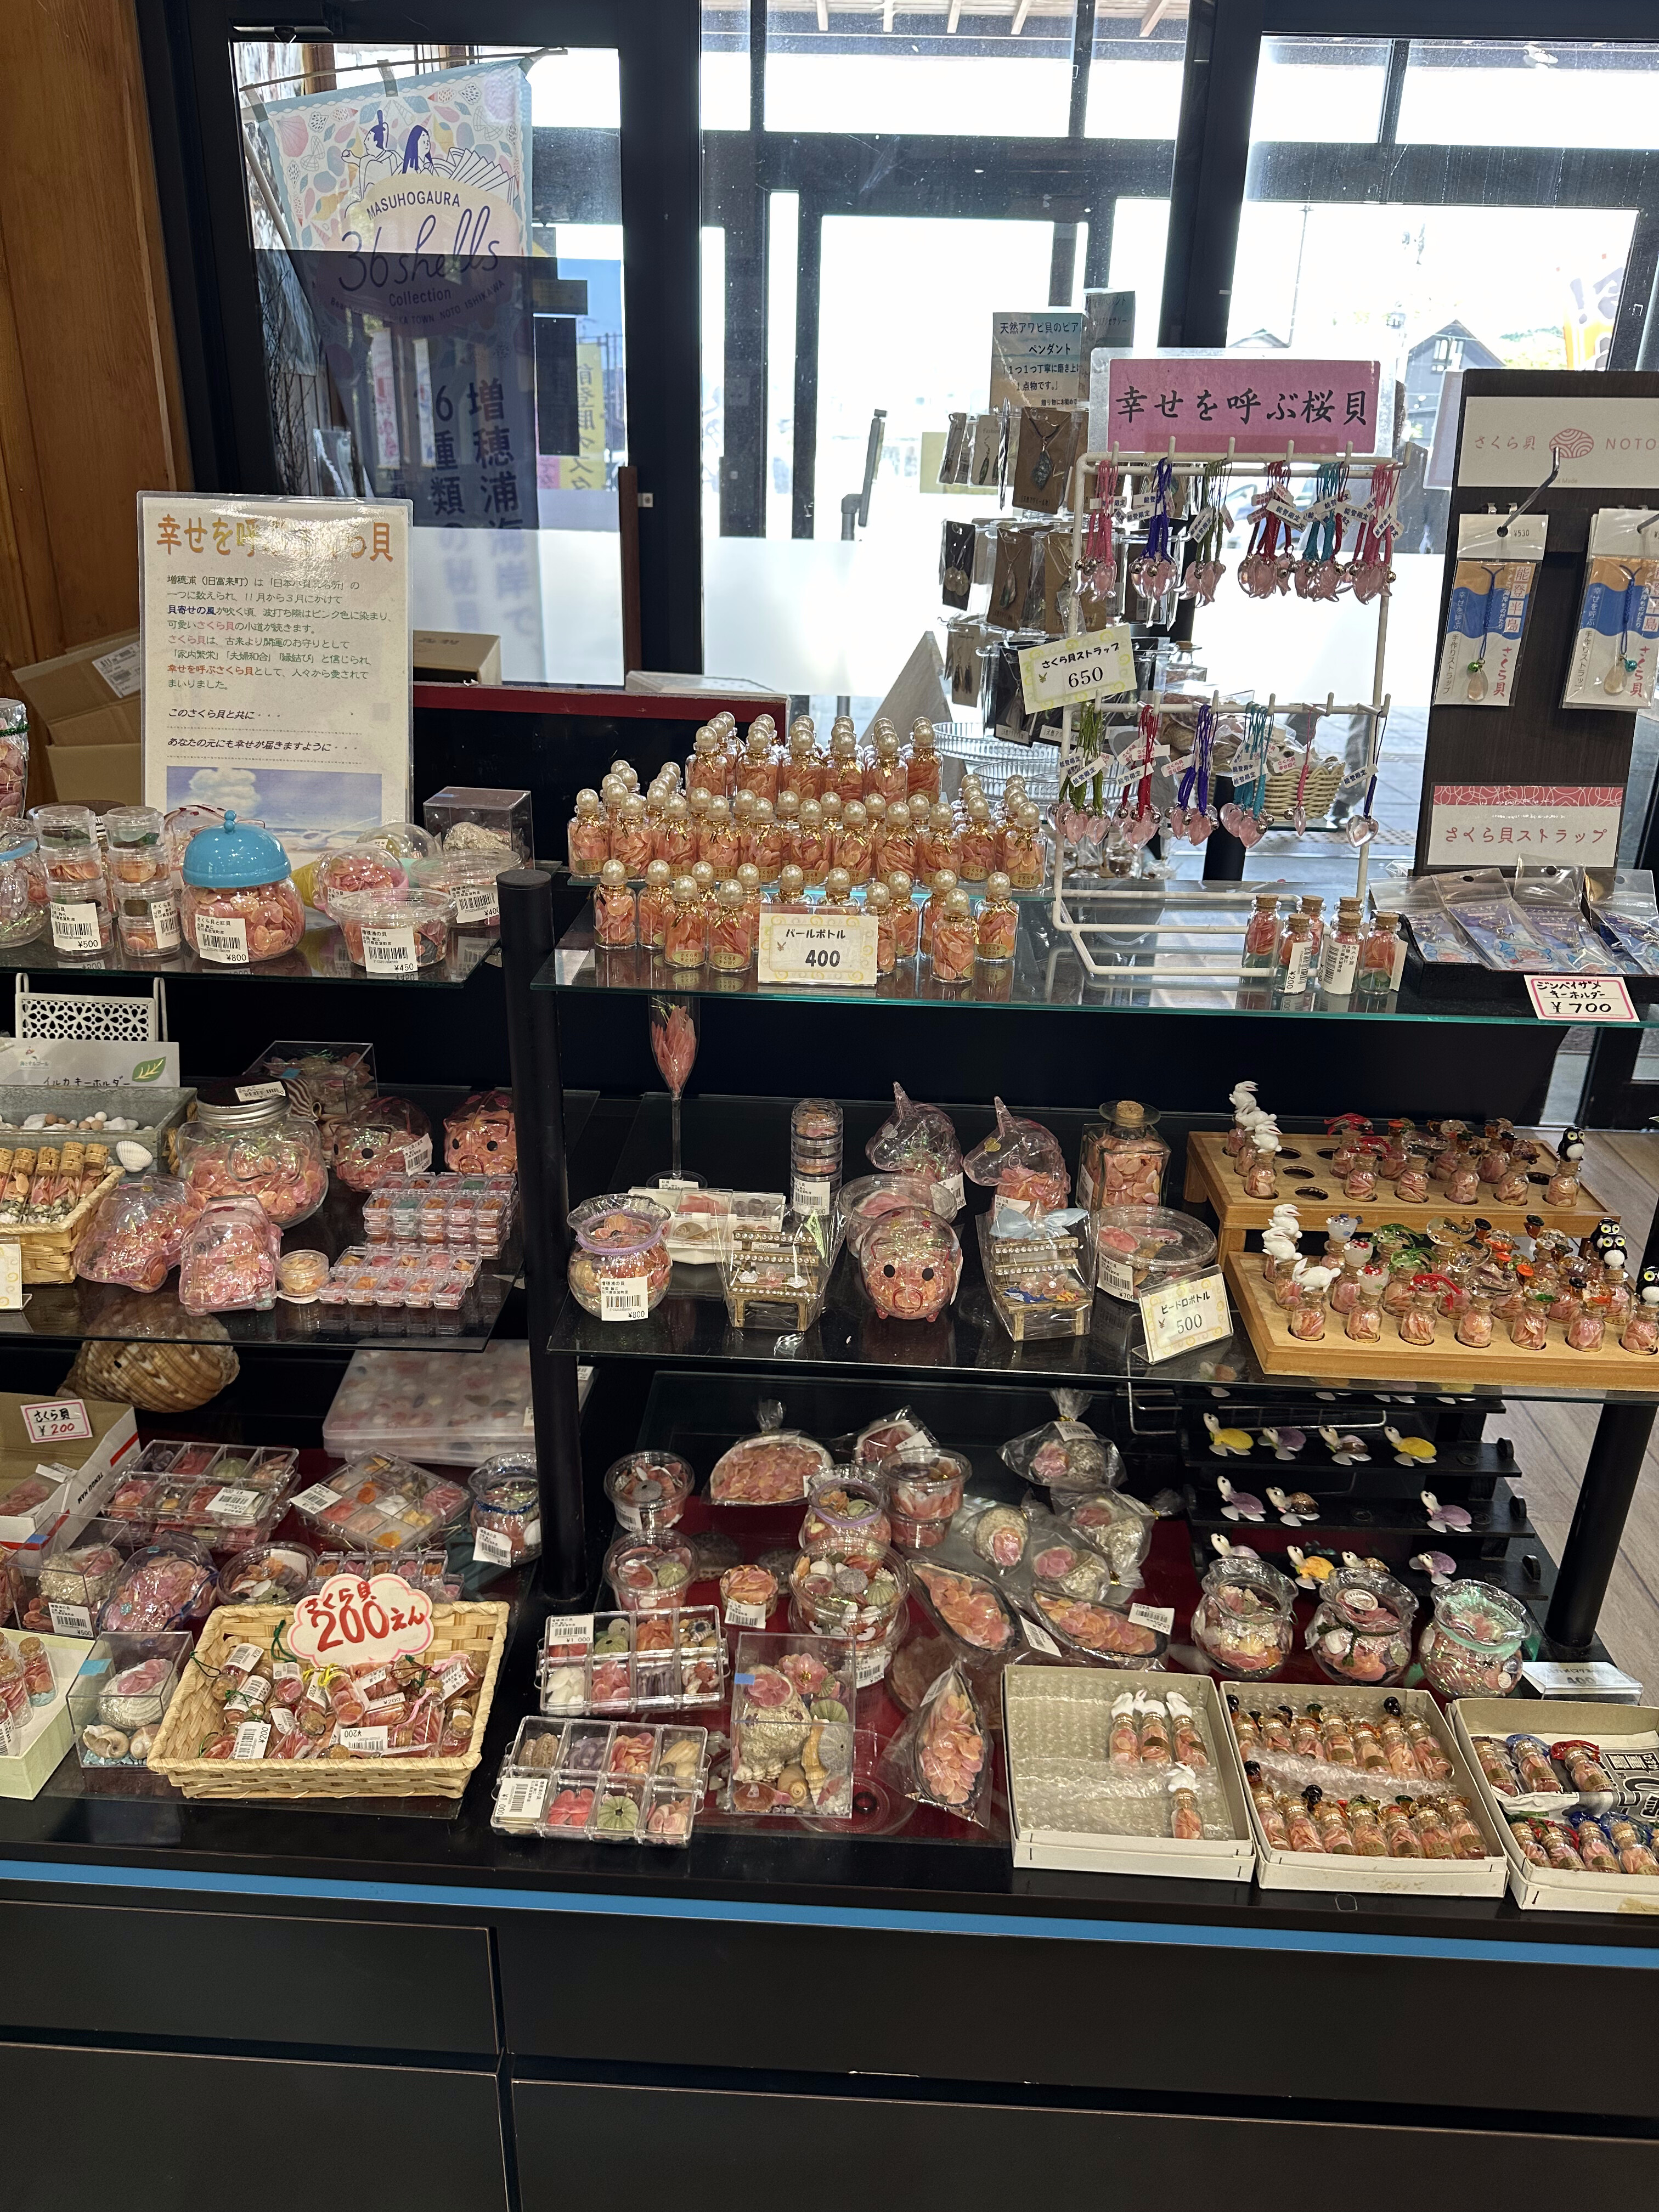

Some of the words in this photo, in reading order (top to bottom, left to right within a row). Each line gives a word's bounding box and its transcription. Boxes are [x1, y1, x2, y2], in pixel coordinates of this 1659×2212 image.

[366, 190, 461, 221] MASUHOGAURA
[388, 287, 452, 307] Collection
[411, 314, 435, 324] TOWN
[464, 279, 506, 310] ISHIKAWA
[1029, 343, 1071, 355] ペンダント
[1115, 385, 1367, 426] 幸せを呼ぶ桜貝
[1475, 435, 1536, 452] さくら貝
[1606, 438, 1657, 450] NOTO
[1275, 505, 1301, 523] 能登限定
[1344, 507, 1369, 521] 能登限定
[1514, 528, 1530, 538] ¥530
[1505, 566, 1531, 633] 能登半島
[1042, 642, 1120, 669] さくら貝ストラップ
[1068, 667, 1103, 688] 650
[1493, 646, 1513, 697] さくら貝
[1630, 646, 1651, 698] さくら貝
[167, 679, 228, 691] まいりました。
[1059, 755, 1081, 768] 能登限定
[1072, 766, 1097, 786] 能登限定
[1118, 770, 1142, 785] 能登限定
[1233, 771, 1256, 785] 能登限定
[1344, 769, 1367, 785] 能登限定
[1445, 826, 1608, 844] さくら貝ストラップ
[785, 929, 846, 939] パールボトル
[77, 939, 98, 948] ¥500
[805, 950, 840, 967] 400
[394, 963, 414, 972] ¥450
[1285, 970, 1296, 990] ¥200
[1537, 980, 1601, 990] ジンベイザメ
[1549, 991, 1606, 1000] キーホルダー
[1568, 1002, 1612, 1013] 700
[1119, 1291, 1135, 1300] ¥700
[1161, 1291, 1210, 1314] ビードロボトル
[628, 1310, 645, 1318] ¥800
[1176, 1313, 1203, 1334] 500
[34, 1408, 71, 1423] さくら貝
[50, 1423, 75, 1435] 200
[304, 1580, 376, 1614] さくら貝
[251, 1648, 262, 1658] ¥200
[257, 1726, 269, 1743] ¥200
[344, 1729, 363, 1738] ¥200
